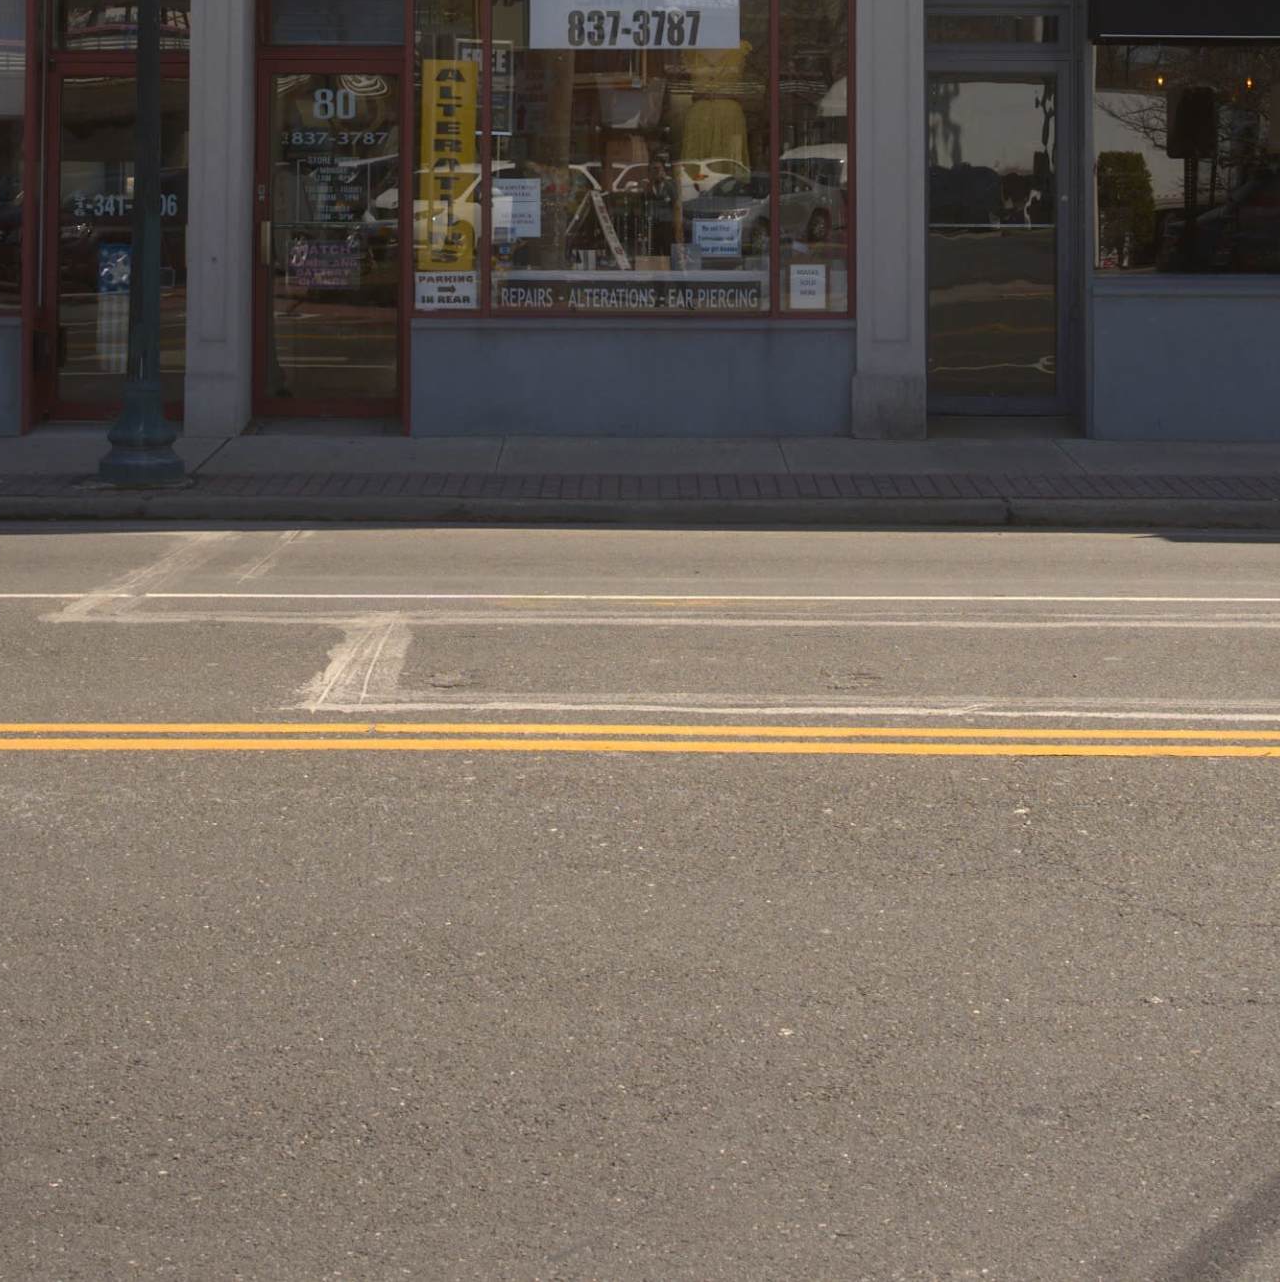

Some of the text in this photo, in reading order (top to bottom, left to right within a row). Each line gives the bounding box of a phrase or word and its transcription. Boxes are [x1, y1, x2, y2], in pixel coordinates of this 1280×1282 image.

[567, 10, 701, 46] 837-3787
[312, 87, 356, 120] 80
[431, 68, 466, 263] ALTERATINS
[418, 275, 474, 284] PARKING
[421, 295, 471, 305] IN REAR
[501, 287, 553, 308] REPAIRS
[567, 287, 655, 309] ALTERATIONS
[668, 288, 693, 309] EAR
[697, 288, 759, 309] PIERCING
